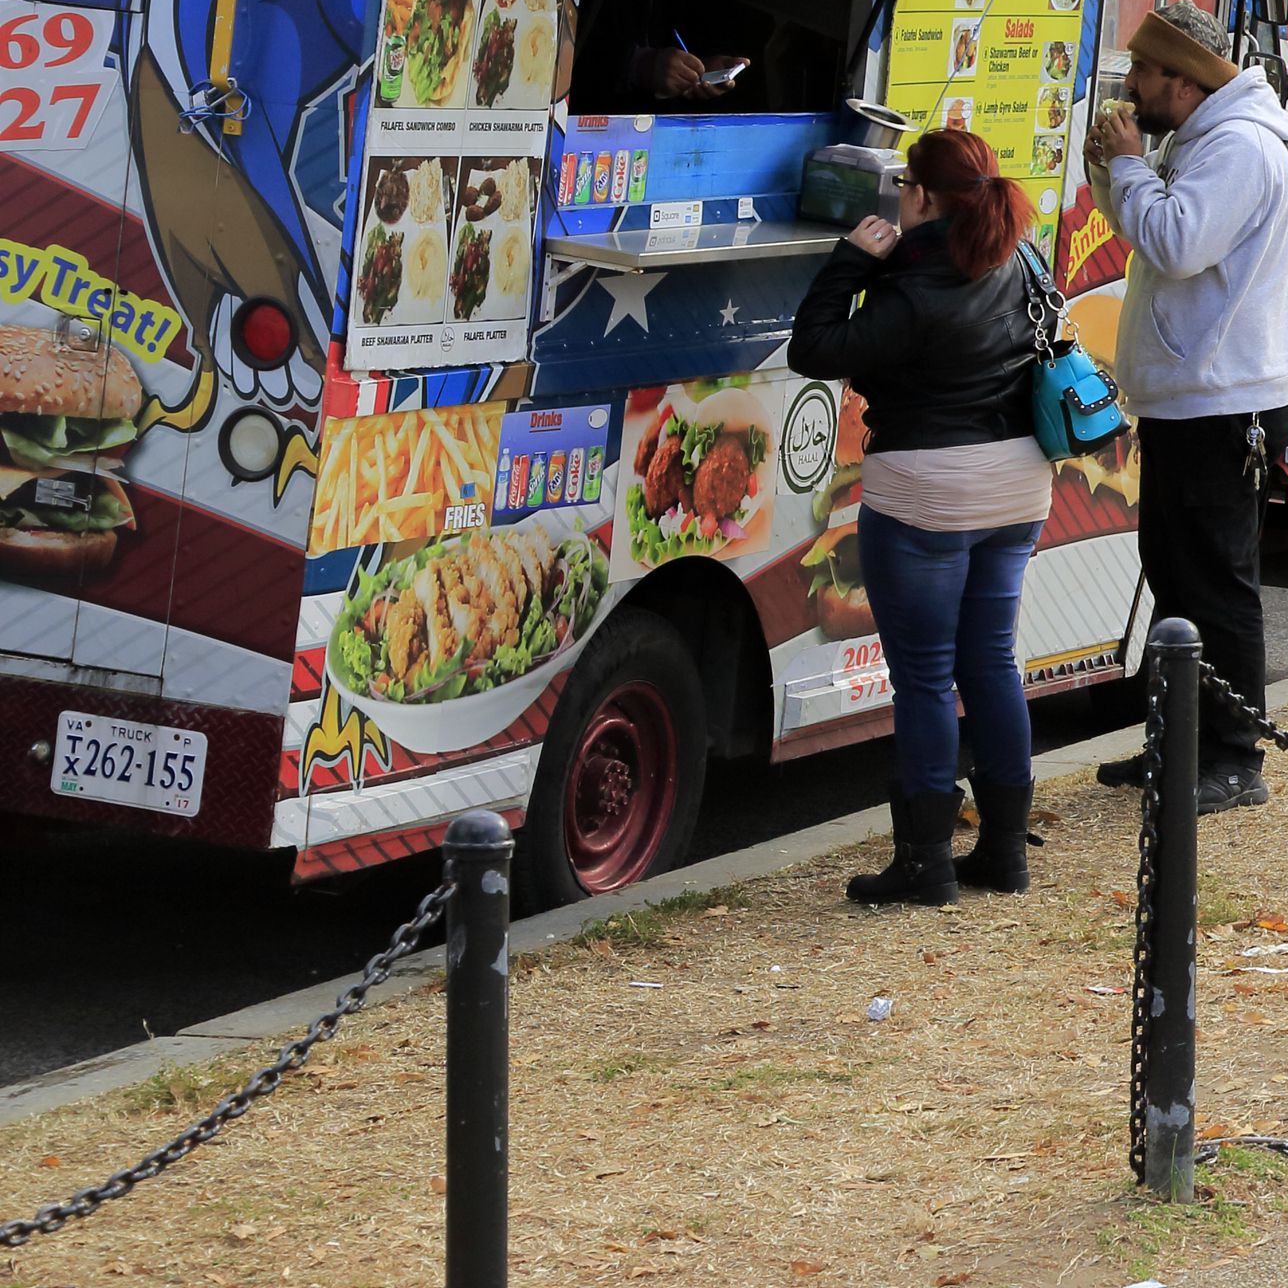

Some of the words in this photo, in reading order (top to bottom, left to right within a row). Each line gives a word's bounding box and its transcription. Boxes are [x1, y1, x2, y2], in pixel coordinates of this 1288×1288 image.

[900, 28, 917, 41] Falafel
[918, 28, 943, 41] Sandwich
[1004, 18, 1034, 38] Salads
[989, 47, 1018, 59] Shawarma
[1018, 47, 1031, 59] Beef
[1032, 48, 1038, 58] or
[988, 60, 1009, 73] Chicken
[983, 101, 999, 114] Lamb
[1000, 101, 1012, 115] Gyro
[1012, 100, 1029, 113] Salad
[381, 121, 405, 131] FALAFEL
[406, 121, 436, 131] SANDWICH
[436, 122, 456, 131] COMBO
[469, 122, 492, 132] CHICKEN
[492, 122, 523, 132] SHAWARMA
[524, 122, 544, 132] PLATTER
[577, 114, 609, 128] Drinks
[1000, 146, 1015, 159] salad
[660, 210, 680, 221] Square
[51, 255, 172, 353] Treat!
[362, 336, 375, 347] BEEF
[377, 336, 410, 346] SHAWARMA
[410, 334, 434, 344] PLATTER
[463, 331, 485, 342] FALAFEL
[486, 330, 507, 340] PLATTER
[530, 411, 563, 428] Drinks
[798, 453, 818, 465] HALAL
[567, 453, 580, 499] Coke
[444, 503, 486, 531] FRIES
[67, 719, 83, 732] VA
[111, 725, 152, 743] TRUCK
[183, 738, 192, 748] P
[83, 738, 196, 792] 262-155
[61, 781, 78, 792] MAY
[176, 799, 190, 809] 17
